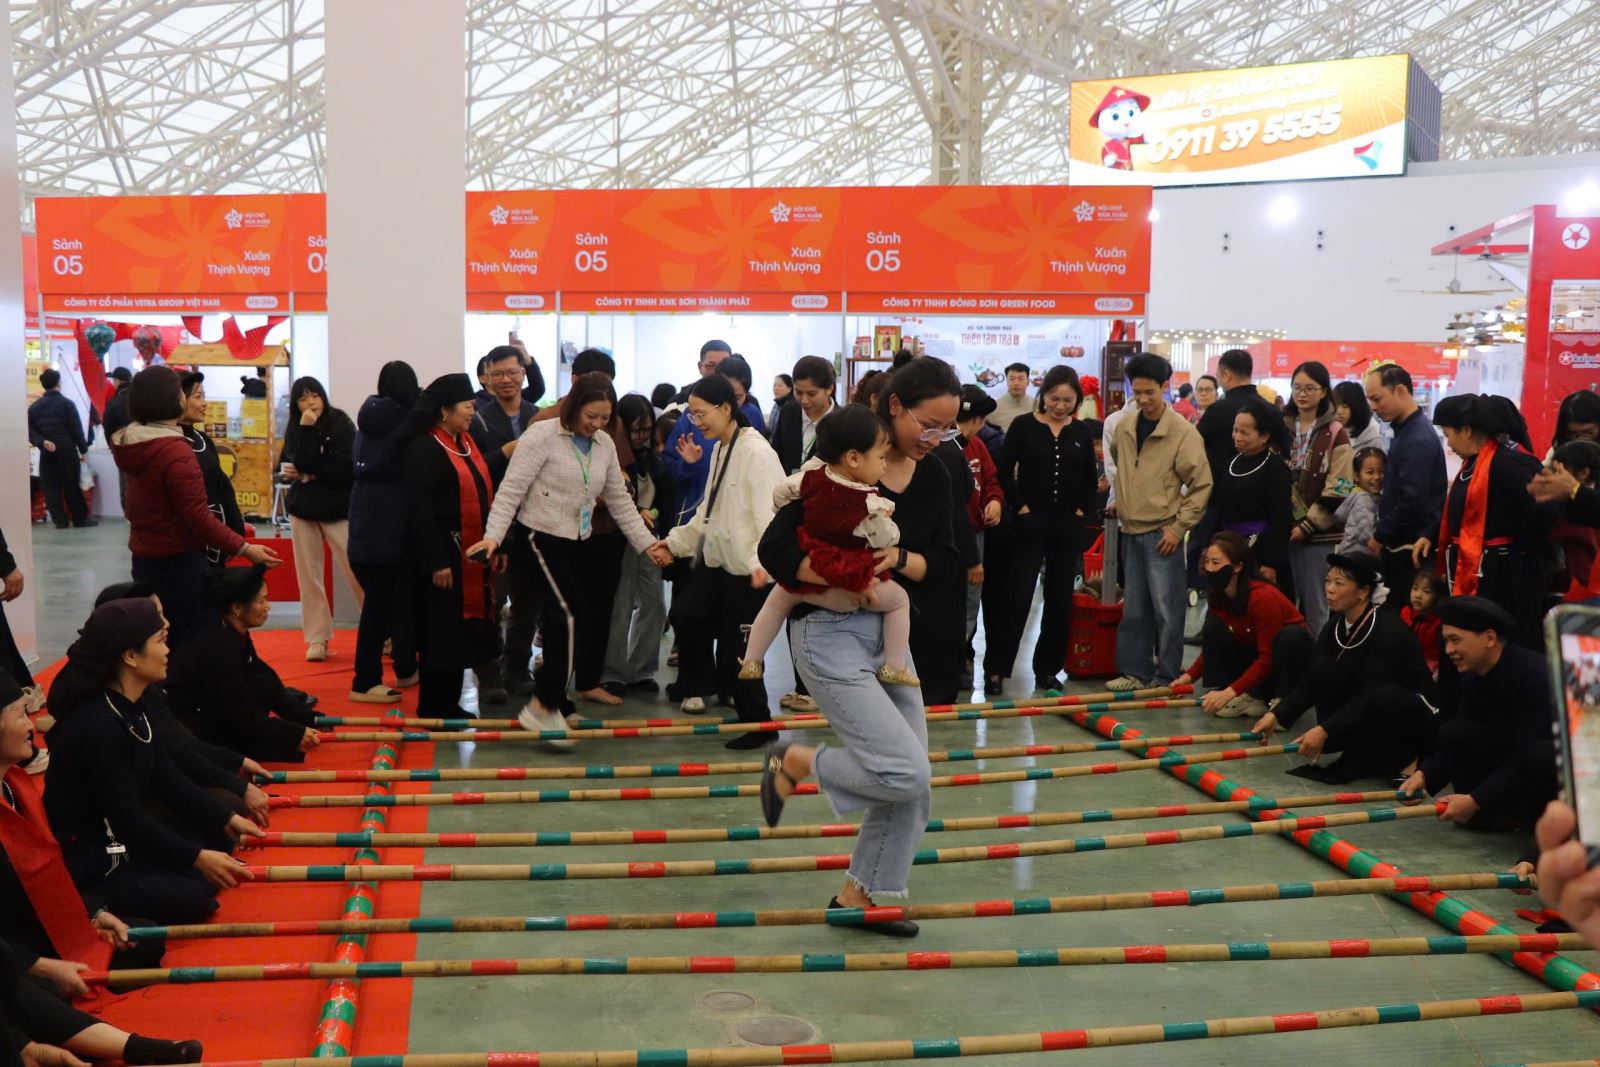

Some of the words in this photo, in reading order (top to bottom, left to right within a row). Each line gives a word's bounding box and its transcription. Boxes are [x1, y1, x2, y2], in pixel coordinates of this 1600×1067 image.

[1149, 124, 1217, 164] 0911
[1219, 117, 1259, 152] 39
[1261, 101, 1344, 145] 5555
[53, 238, 83, 250] Sảnh
[307, 234, 327, 247] Sả
[575, 232, 608, 245] Sảnh
[866, 231, 901, 244] Sảnh
[243, 251, 270, 260] Xuân
[509, 248, 538, 258] Xuân
[791, 247, 821, 257] Xuân
[1094, 246, 1126, 257] Xuân
[53, 254, 84, 275] 05
[307, 252, 327, 273] 0
[575, 250, 608, 272] 05
[866, 249, 901, 272] 05
[207, 264, 235, 277] Thịnh
[237, 264, 271, 276] Vượng
[470, 262, 500, 275] Thịnh
[502, 262, 538, 275] Vượng
[749, 261, 781, 275] Thịnh
[783, 261, 821, 275] Vượng
[1050, 261, 1084, 275] Thịnh
[1086, 261, 1126, 275] Vượng
[596, 296, 621, 306] CÔNG
[624, 298, 633, 306] TY
[635, 298, 657, 306] TNHH
[659, 298, 676, 306] XNK
[728, 296, 751, 306] PHÁT
[882, 297, 910, 307] CÔNG
[912, 298, 923, 307] TY
[924, 298, 948, 307] TNHH
[999, 299, 1028, 308] GREEN
[1030, 299, 1056, 308] FOOD
[235, 491, 260, 506] EAD
